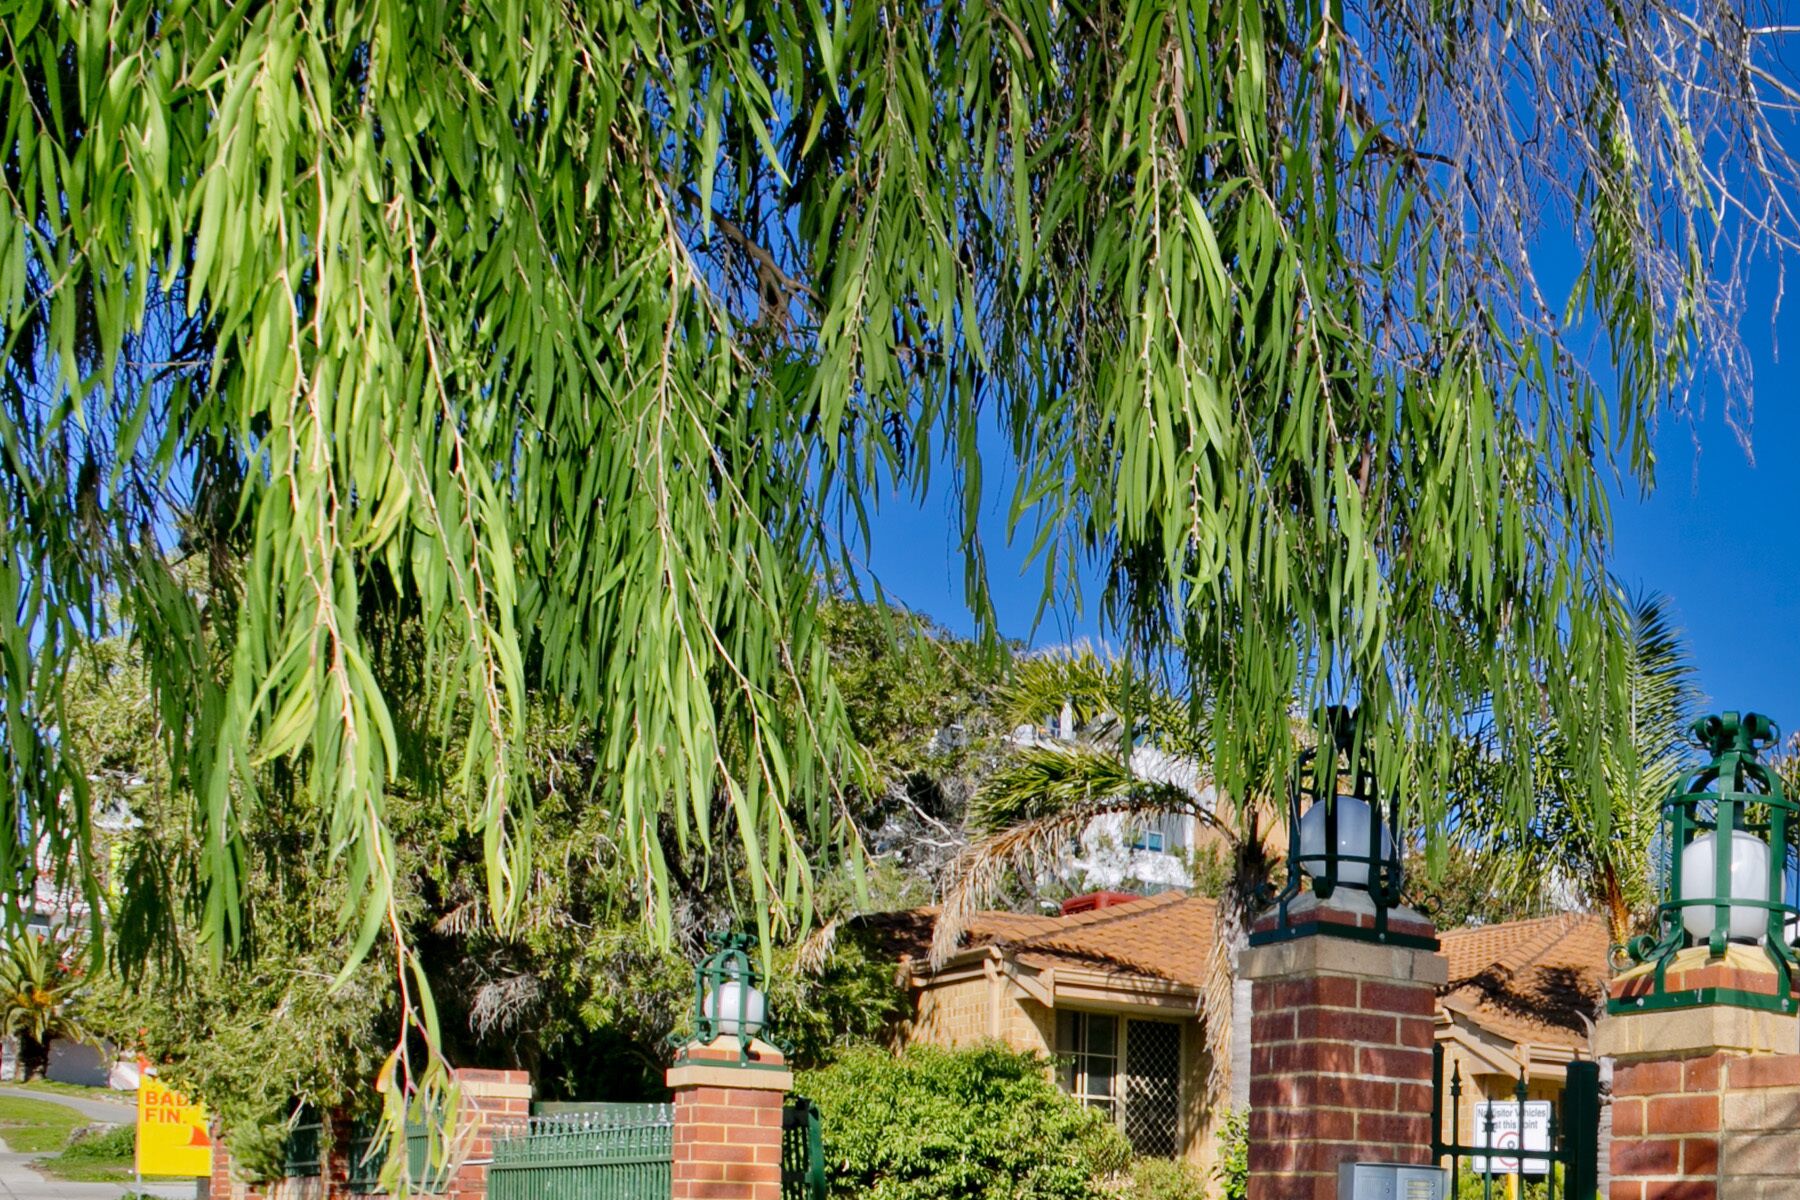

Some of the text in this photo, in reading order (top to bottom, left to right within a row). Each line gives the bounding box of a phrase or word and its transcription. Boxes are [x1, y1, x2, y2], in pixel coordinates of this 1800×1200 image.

[145, 1090, 189, 1106] BAD
[145, 1108, 188, 1123] FIN.
[1514, 1108, 1546, 1118] Vhicles
[1503, 1120, 1517, 1129] this
[1521, 1120, 1538, 1129] oint
